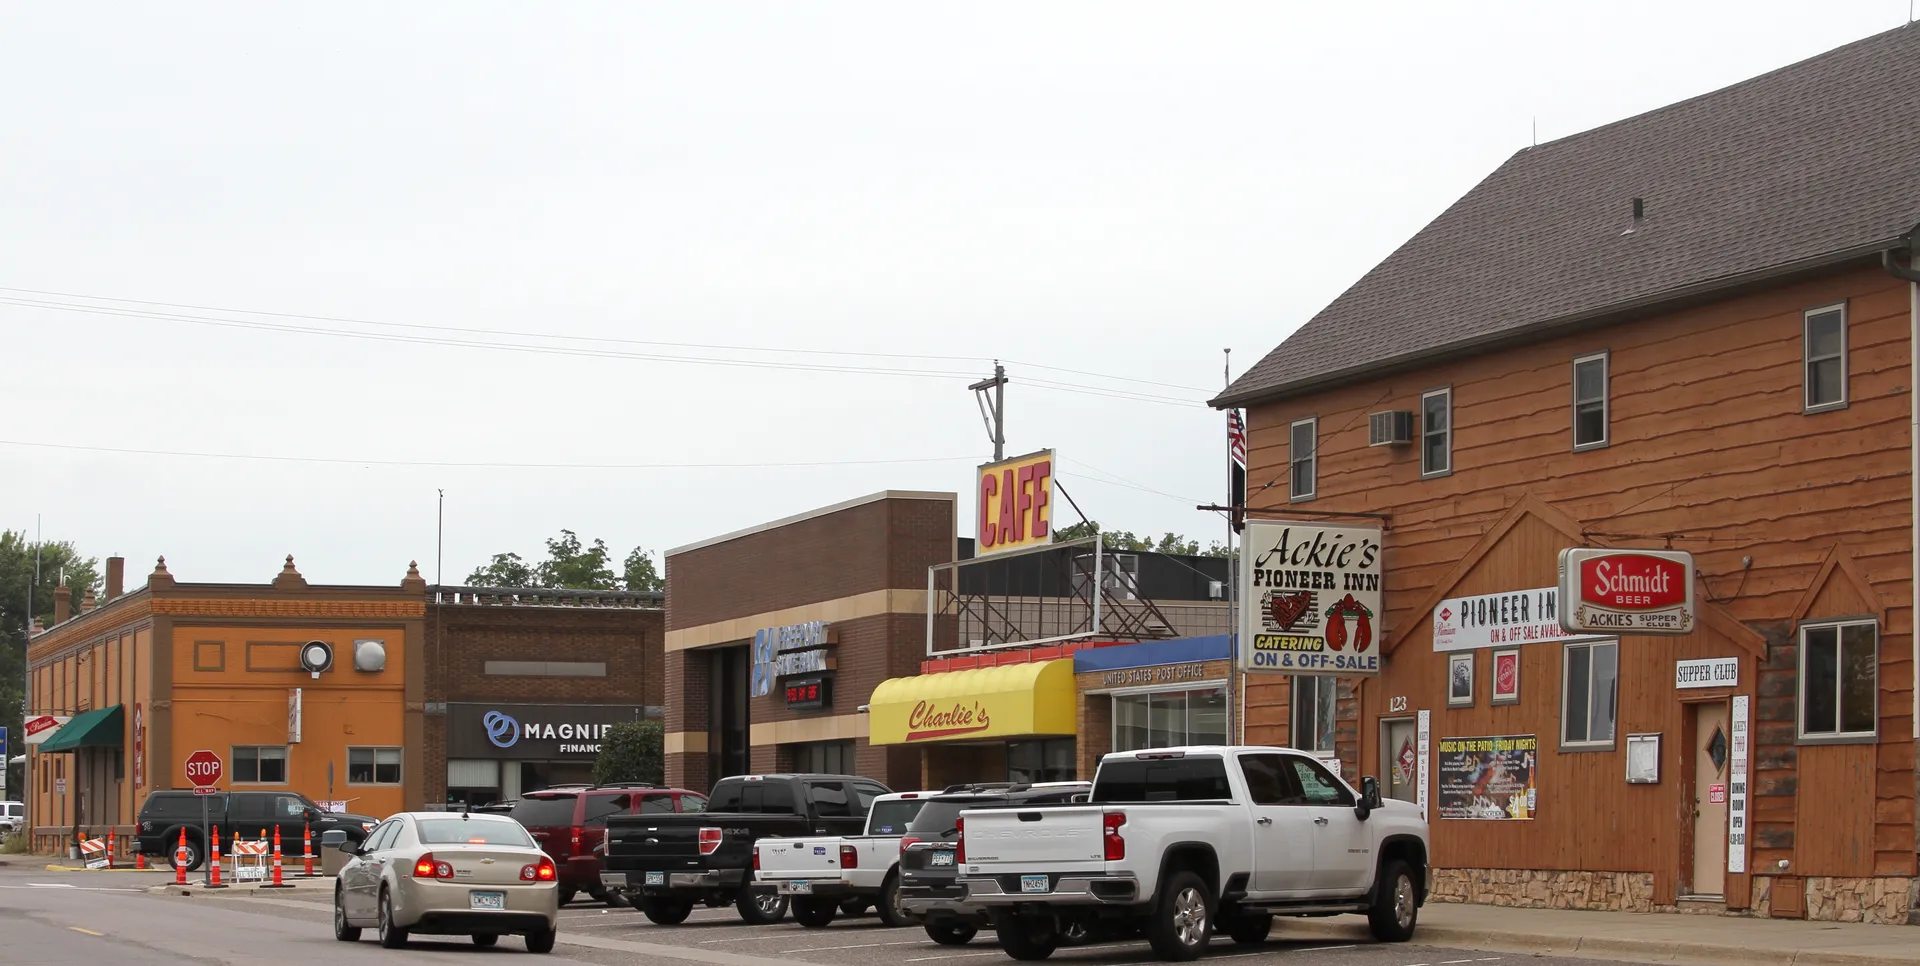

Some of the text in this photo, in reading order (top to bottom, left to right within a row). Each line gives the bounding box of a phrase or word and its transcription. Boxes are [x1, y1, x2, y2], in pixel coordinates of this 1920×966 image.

[980, 461, 1051, 548] CAFE
[1255, 527, 1380, 569] Ackie's
[1253, 568, 1380, 592] PIONEER INN
[1595, 560, 1670, 596] Schmidt
[1616, 595, 1651, 605] BEER
[1461, 593, 1530, 629] PIONEER
[1589, 613, 1677, 627] ACKIE'S SUPPER
[777, 621, 829, 651] FREEPORT
[1490, 628, 1500, 643] ON
[1502, 627, 1507, 641] &
[1509, 626, 1522, 641] OFF
[1523, 625, 1539, 640] SALE
[1256, 635, 1323, 651] CATERING
[1254, 652, 1377, 669] ON & OFF-SALE
[1103, 664, 1203, 685] UNITED STATES POST OFFICE
[1678, 663, 1737, 682] SUPPER CLUB
[1390, 696, 1407, 712] 123
[908, 699, 989, 731] Charlie's
[560, 744, 602, 753] FINANC
[1440, 741, 1456, 753] MUSIC
[1457, 741, 1465, 752] ON
[1466, 741, 1476, 752] THE
[1477, 740, 1493, 752] PATIO
[1495, 739, 1514, 752] FRIDAY
[1516, 738, 1536, 751] NIGHTS
[188, 762, 219, 776] STOP
[1731, 782, 1746, 794] DINING
[1732, 799, 1744, 811] ROOM
[1732, 816, 1743, 828] OPEN
[971, 827, 1094, 840] CHEVROLET
